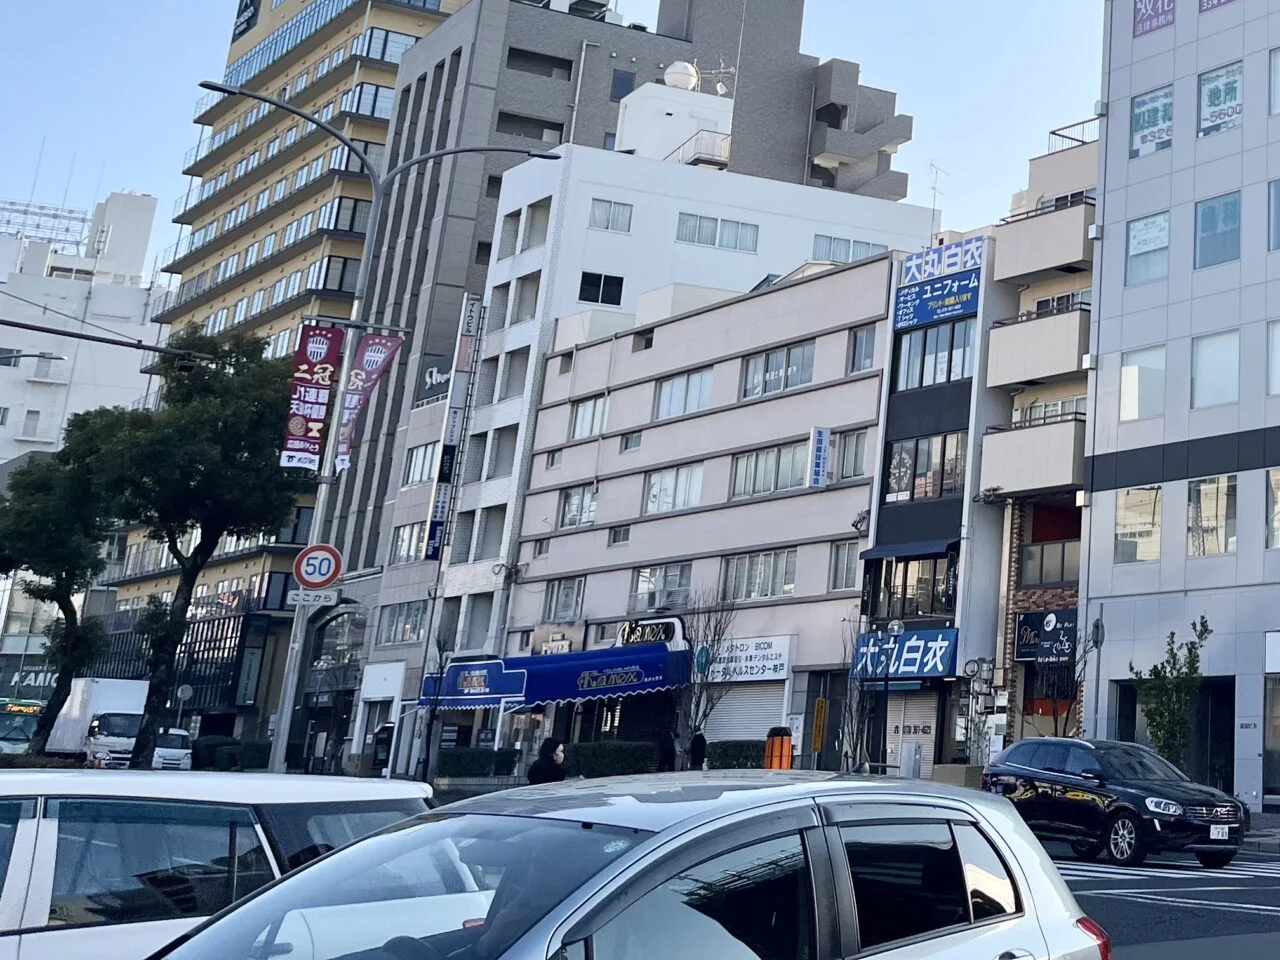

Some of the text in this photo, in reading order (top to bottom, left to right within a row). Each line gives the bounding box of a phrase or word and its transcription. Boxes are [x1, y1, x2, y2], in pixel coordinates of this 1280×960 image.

[904, 238, 983, 283] 大丸白衣
[922, 273, 979, 299] ユニフォーム
[294, 363, 335, 385] 二冠
[303, 556, 332, 577] 50
[291, 593, 334, 604] ここから
[725, 643, 750, 653] メタトロン
